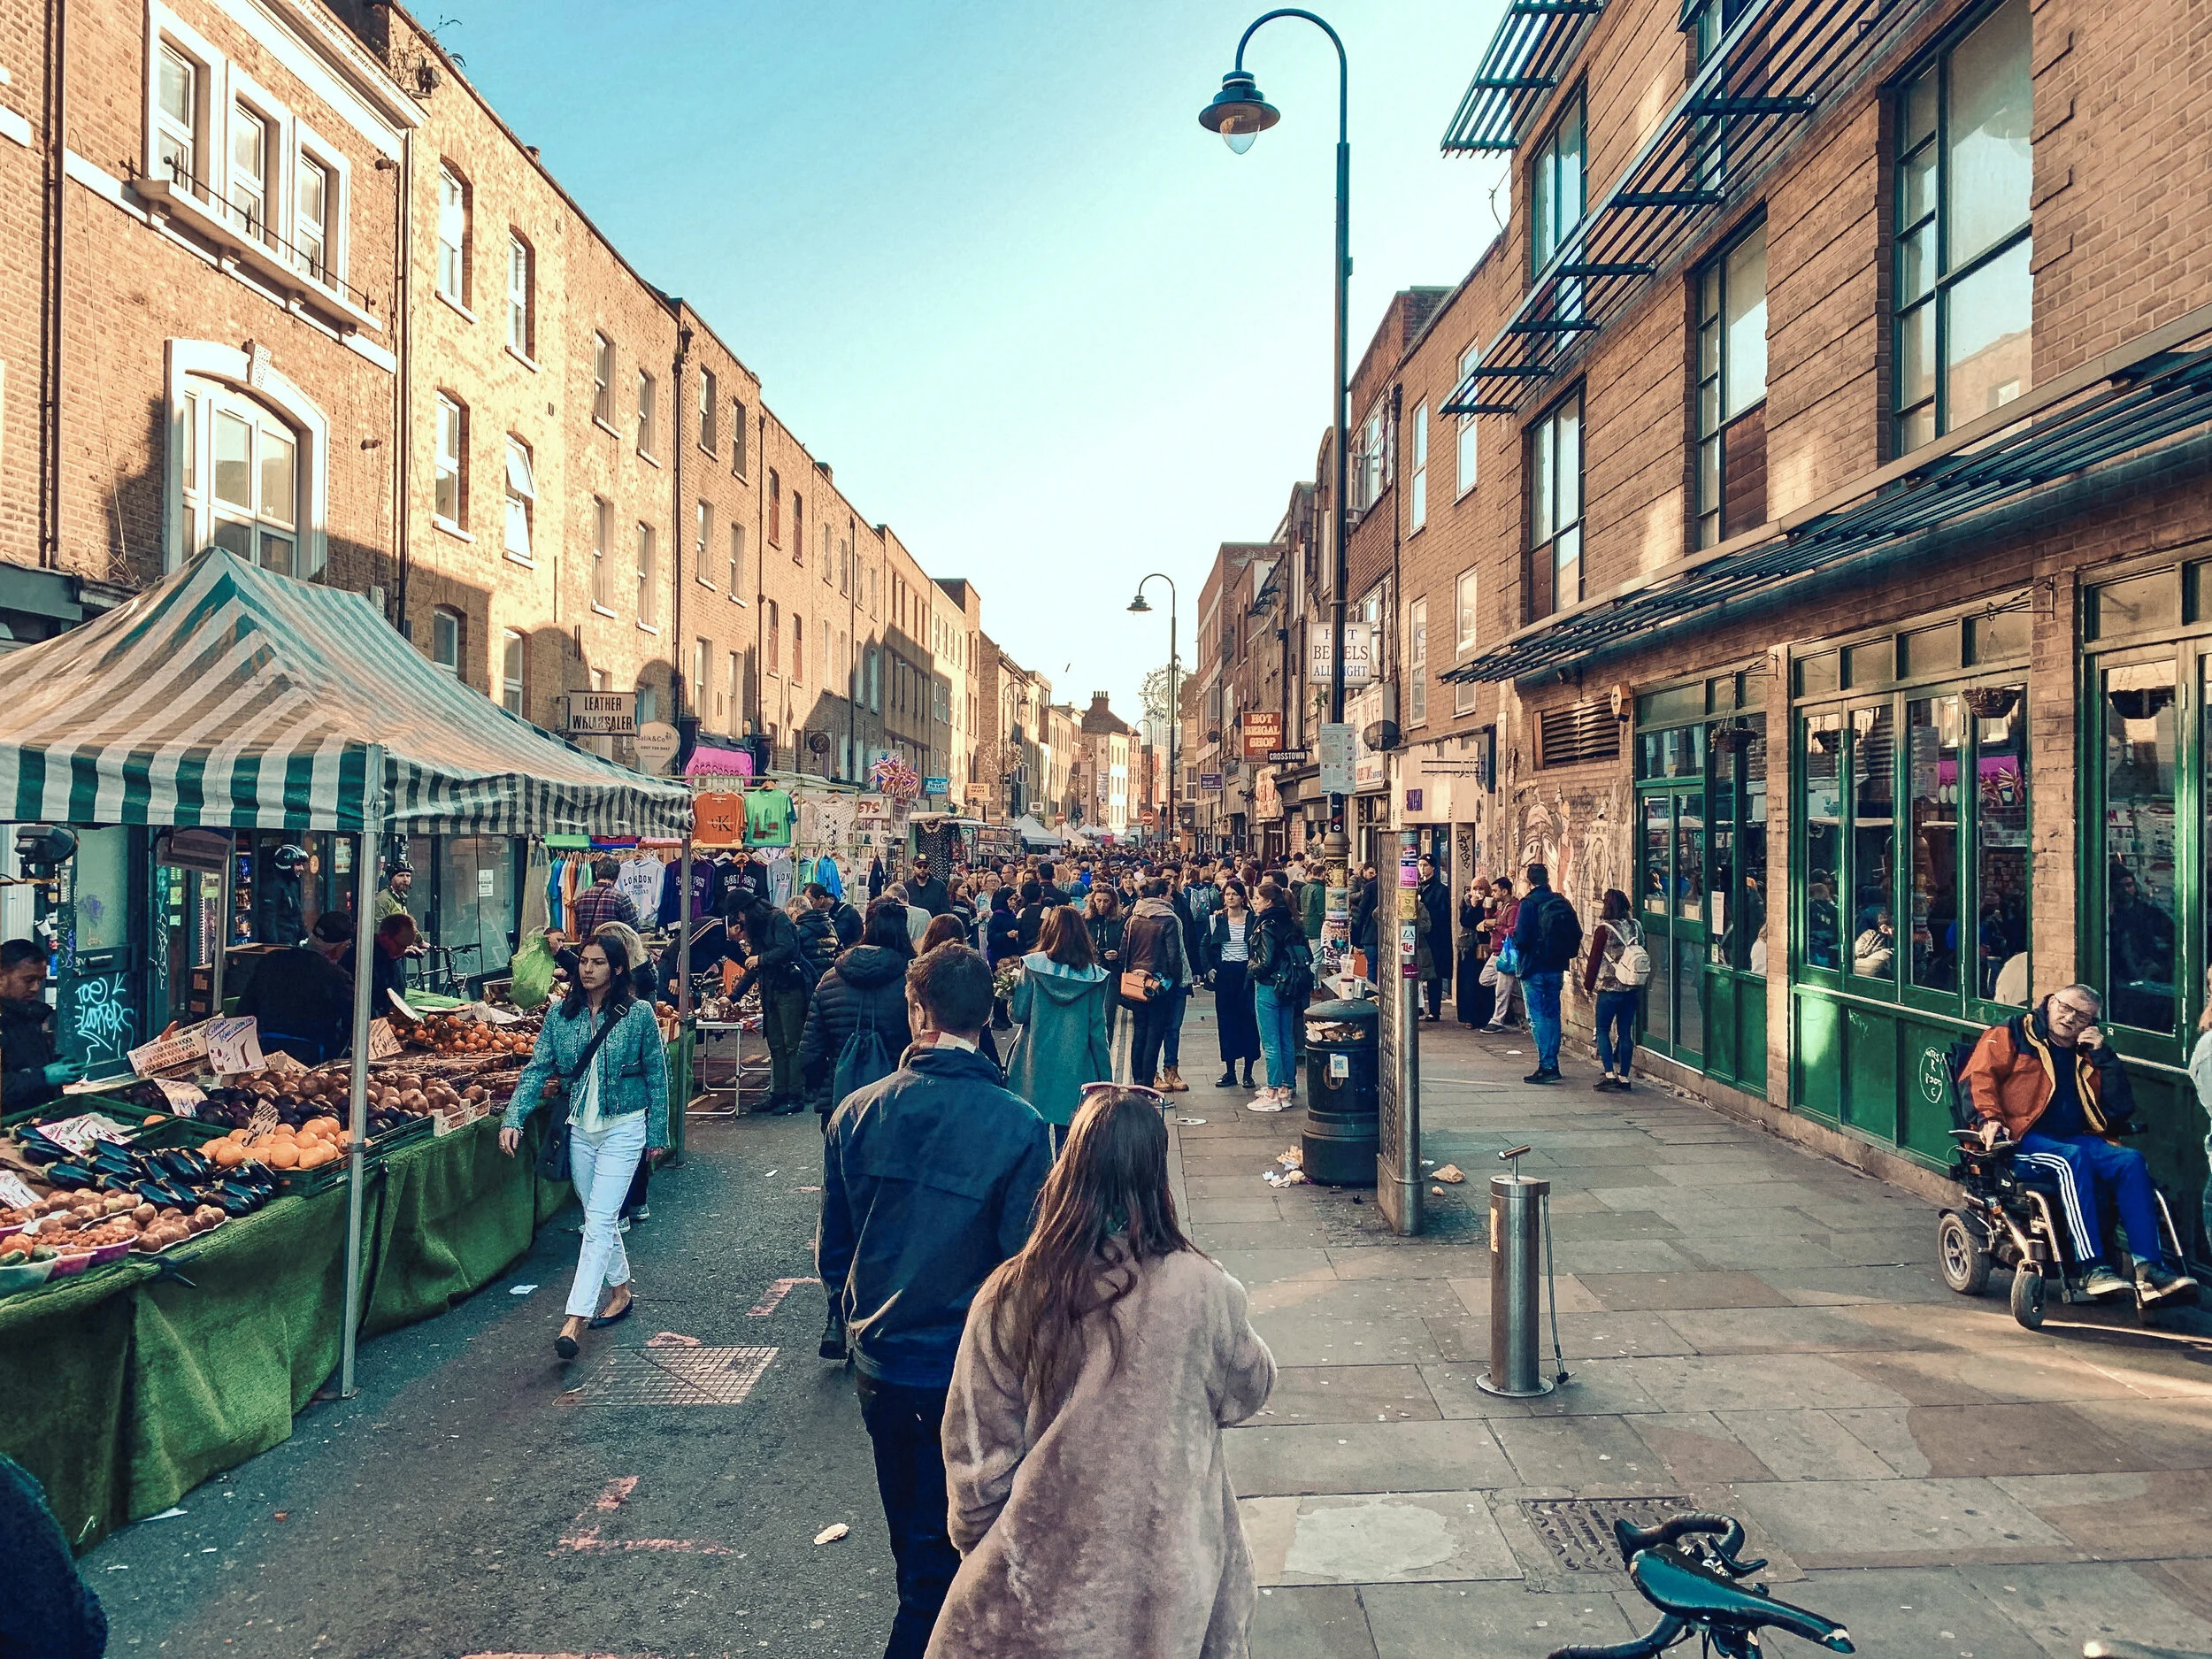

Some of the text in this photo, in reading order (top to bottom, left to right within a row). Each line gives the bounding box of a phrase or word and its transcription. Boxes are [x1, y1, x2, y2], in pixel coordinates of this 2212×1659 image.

[1325, 628, 1357, 640] HT
[1313, 645, 1369, 660] BEELS
[1313, 665, 1332, 677] ALL
[584, 696, 622, 711] LEATHER
[1250, 714, 1273, 724] HOT
[1249, 737, 1276, 748] SHOP
[1269, 752, 1305, 761] CROSSTOWN
[623, 874, 653, 887] LONDON
